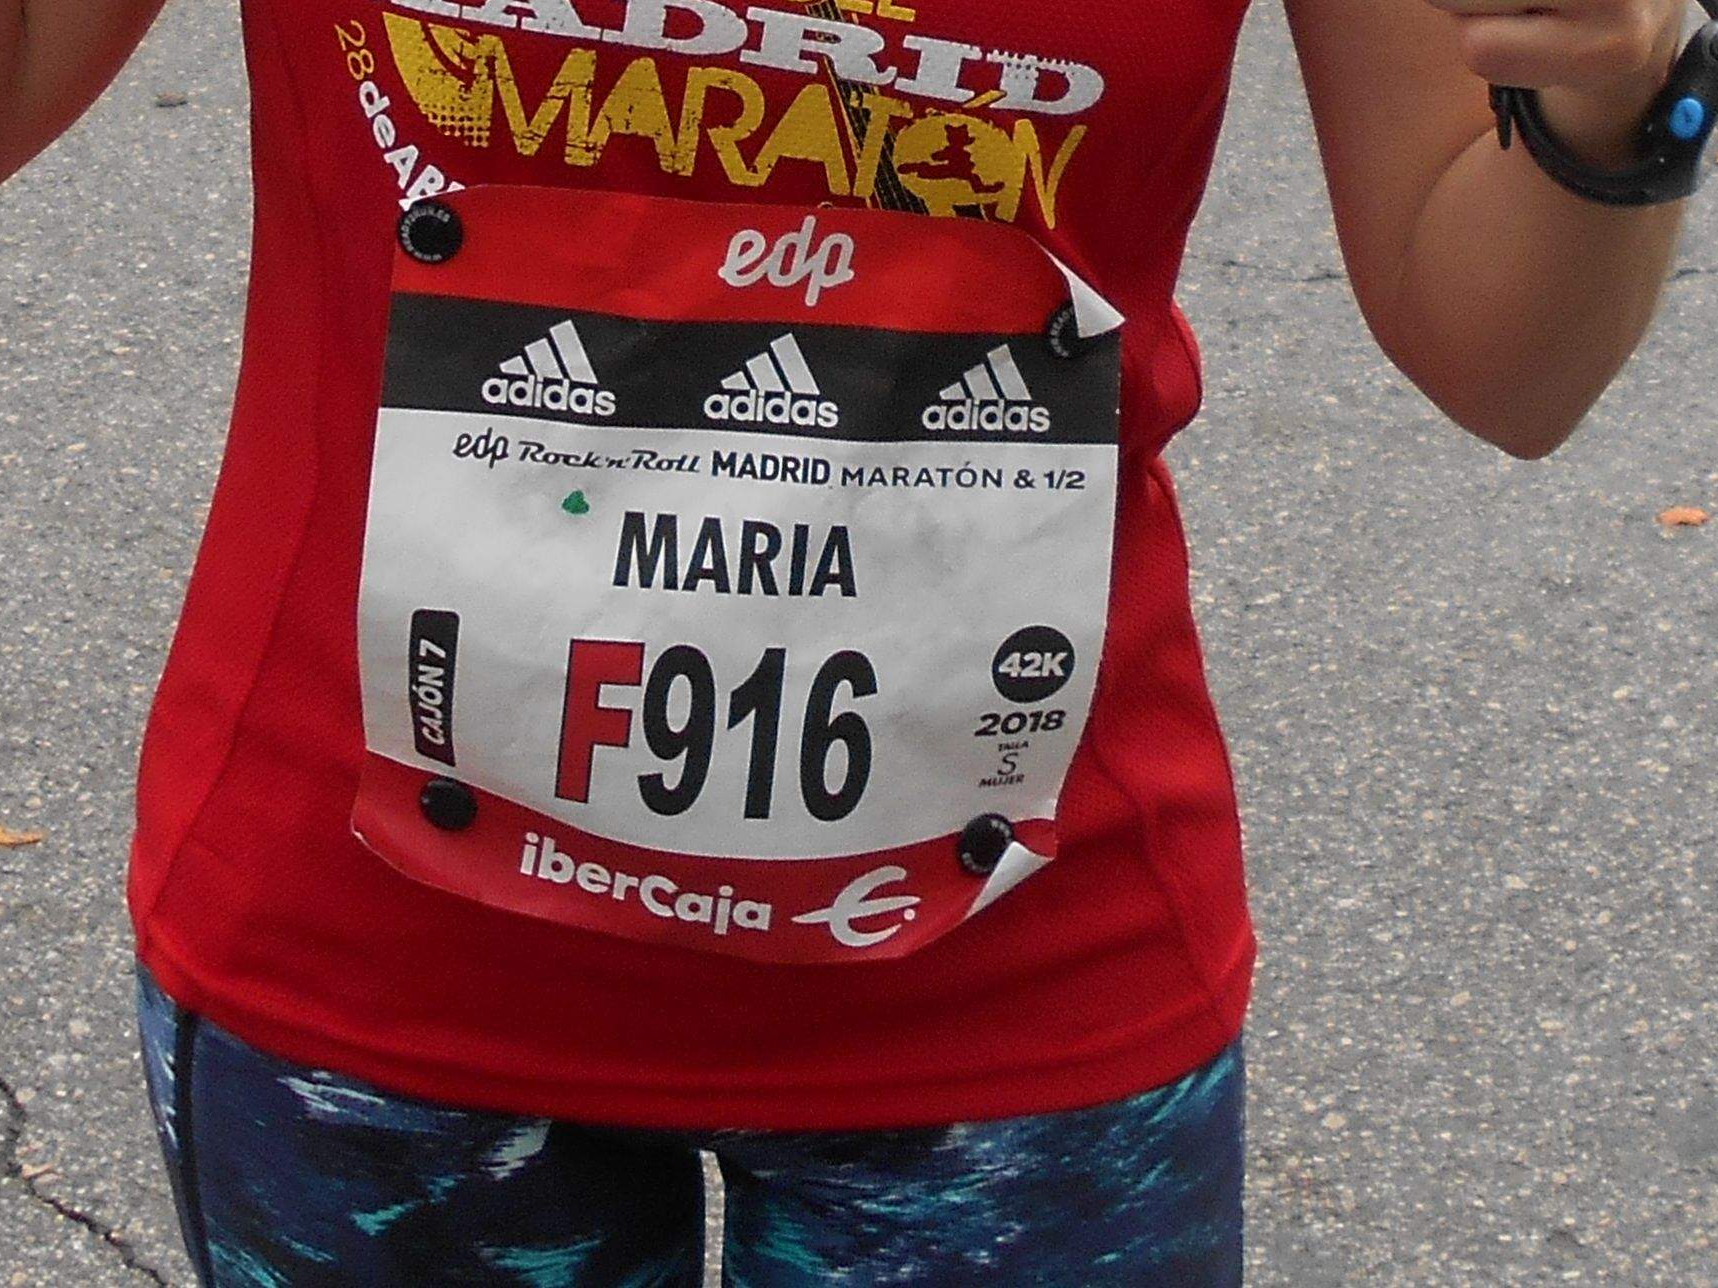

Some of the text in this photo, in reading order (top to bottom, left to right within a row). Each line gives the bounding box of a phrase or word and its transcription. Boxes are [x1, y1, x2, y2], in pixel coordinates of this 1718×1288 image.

[718, 216, 854, 306] edp
[482, 373, 616, 417] adidas
[703, 389, 839, 428] adidas
[921, 398, 1051, 433] adidas
[452, 427, 510, 469] edp
[711, 450, 830, 486] MADRID
[841, 461, 1003, 489] MARATÓN
[1013, 469, 1036, 489] &
[1043, 469, 1086, 490] 1/2
[612, 510, 858, 598] MARIA
[998, 651, 1068, 678] 42K
[412, 638, 446, 745] CAJÓN 7
[554, 637, 879, 822] F916
[974, 709, 1067, 737] 2018
[997, 752, 1019, 776] S
[519, 831, 772, 935] iberCaja
